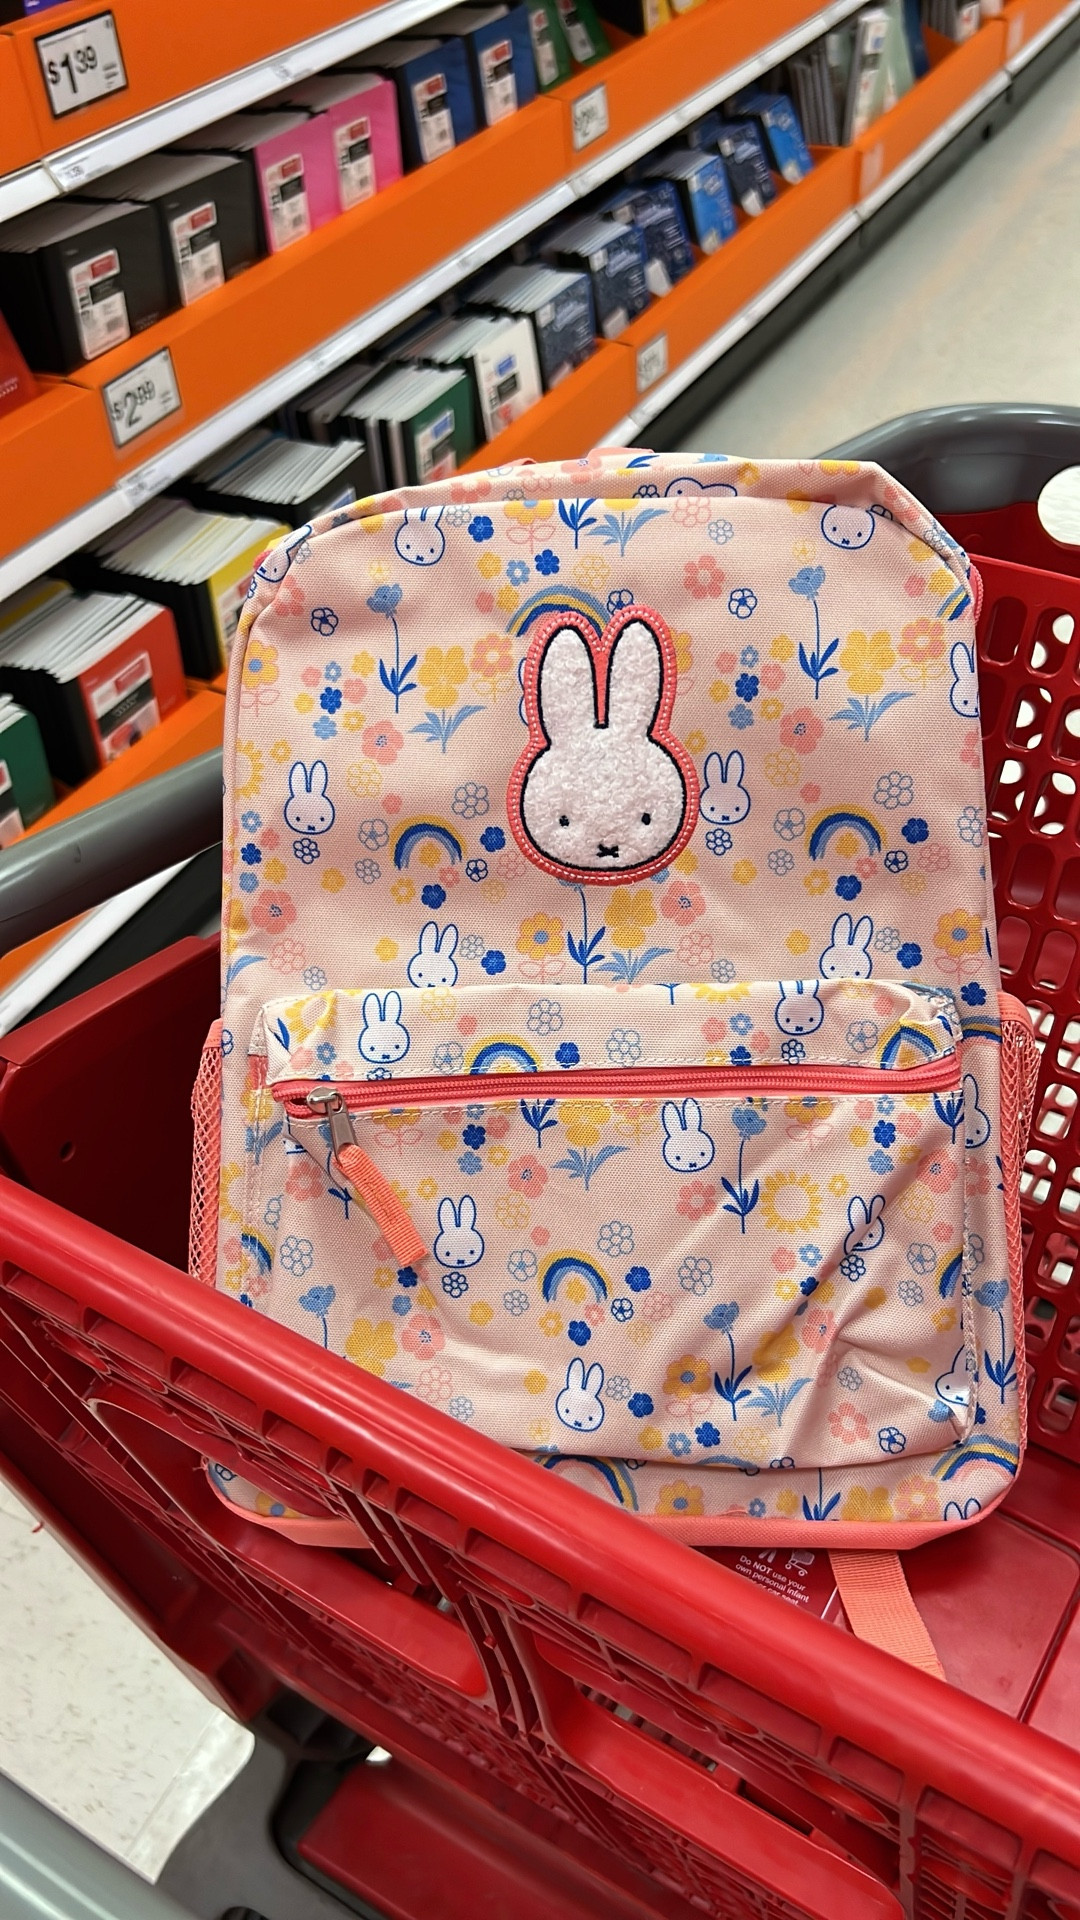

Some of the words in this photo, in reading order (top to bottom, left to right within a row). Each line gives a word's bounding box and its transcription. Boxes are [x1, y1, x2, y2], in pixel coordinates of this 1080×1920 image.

[735, 1563, 752, 1576] own
[752, 1571, 787, 1592] personal
[786, 1586, 810, 1603] infant
[739, 1555, 752, 1566] Do
[752, 1561, 773, 1575] NOT
[772, 1571, 787, 1583] use
[787, 1579, 806, 1592] your
